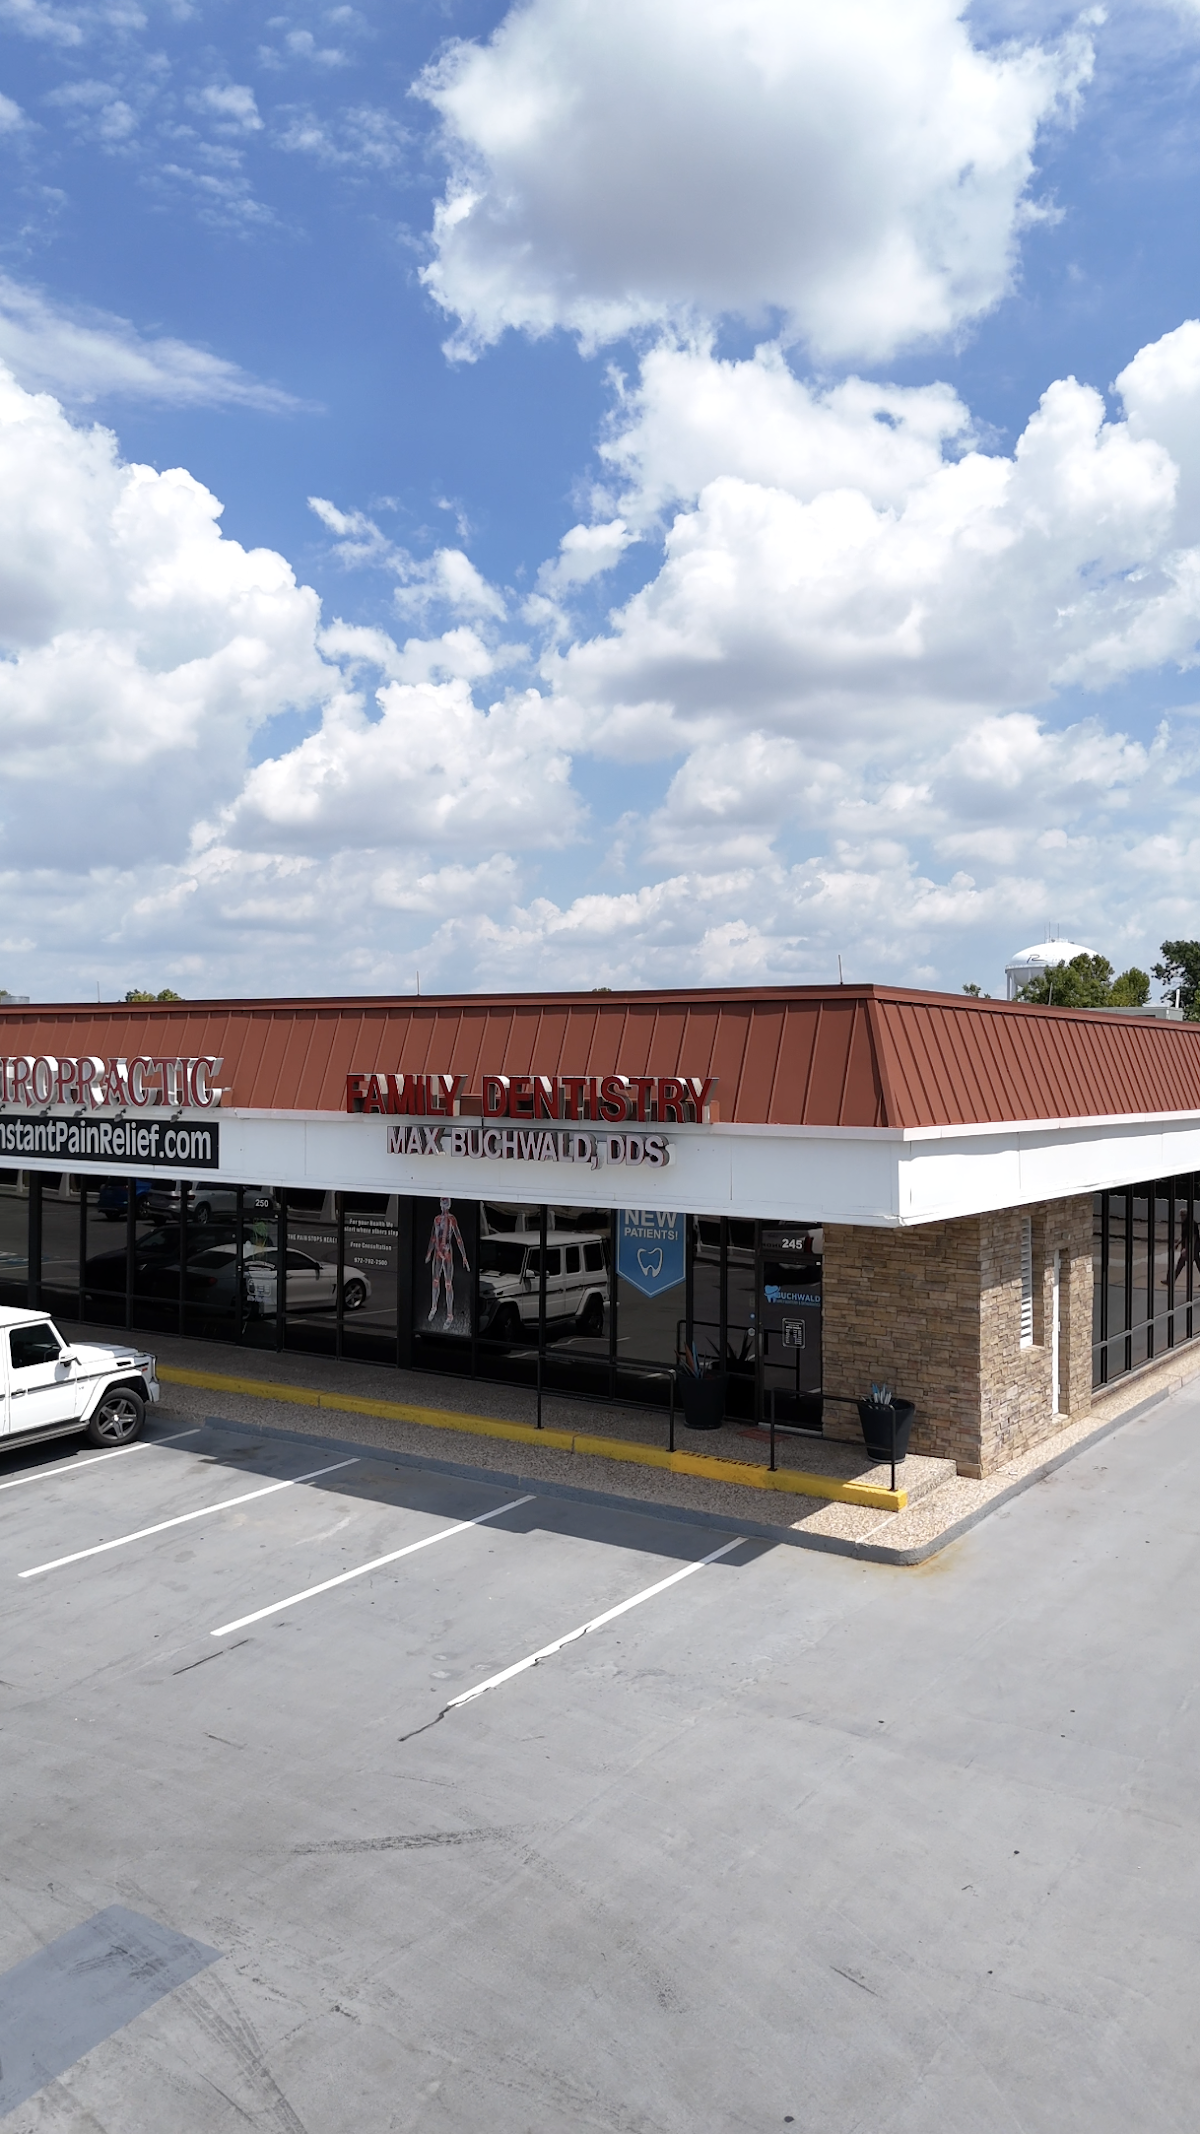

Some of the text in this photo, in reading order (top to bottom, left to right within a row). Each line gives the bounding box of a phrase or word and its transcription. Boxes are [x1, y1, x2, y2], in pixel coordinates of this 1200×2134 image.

[347, 1074, 718, 1123] FAMILY DENTISTRY
[387, 1126, 669, 1170] MAX BUCHWALD, DDS
[255, 1199, 269, 1208] 250
[624, 1209, 677, 1229] NEW
[624, 1227, 678, 1240] PATIENTS!
[782, 1238, 802, 1249] 245
